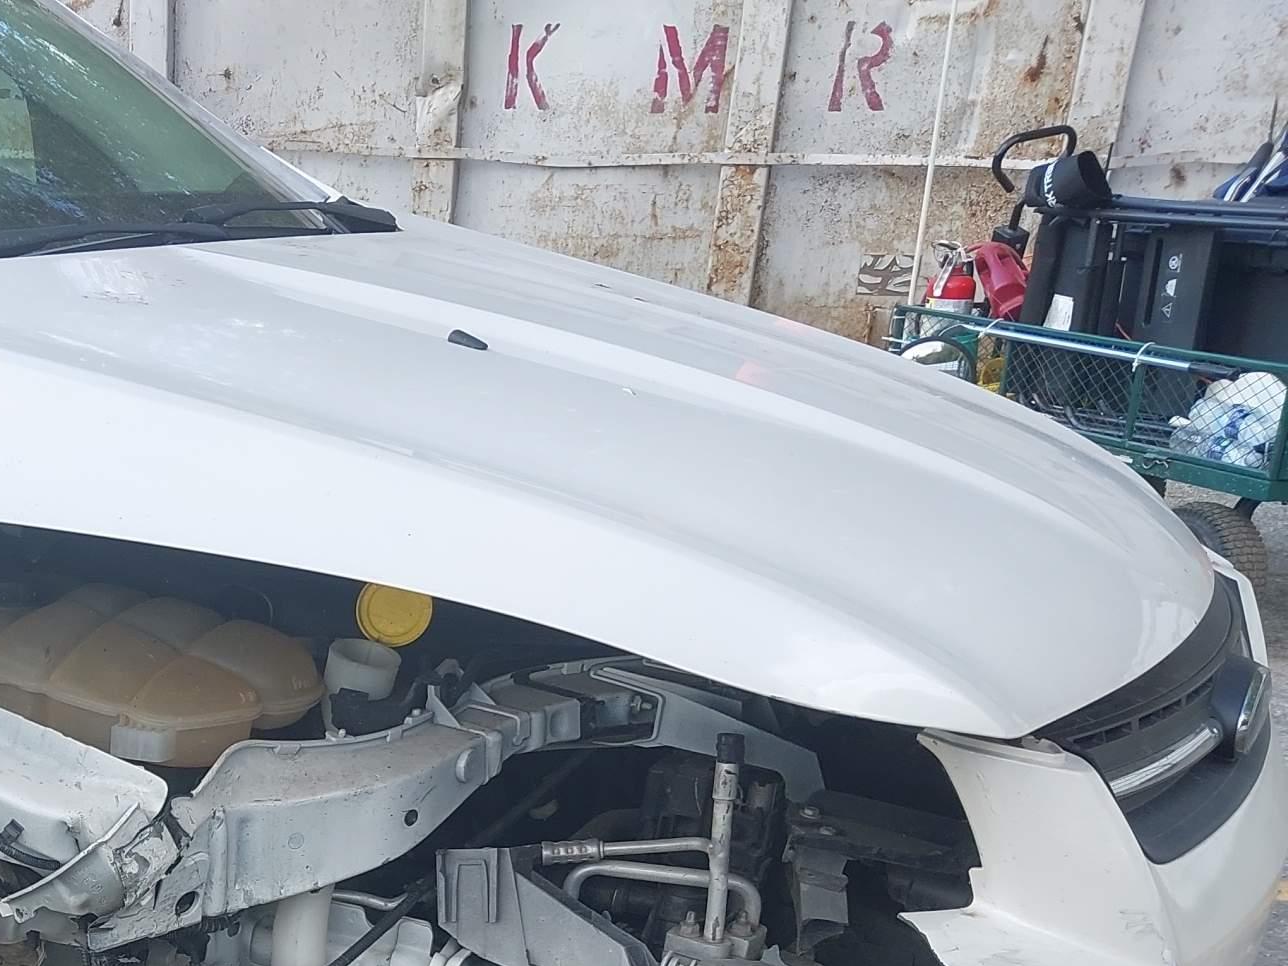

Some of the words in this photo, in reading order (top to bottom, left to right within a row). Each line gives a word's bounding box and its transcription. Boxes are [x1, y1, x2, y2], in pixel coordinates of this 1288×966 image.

[504, 22, 561, 111] K
[649, 24, 730, 114] M
[827, 20, 894, 113] R
